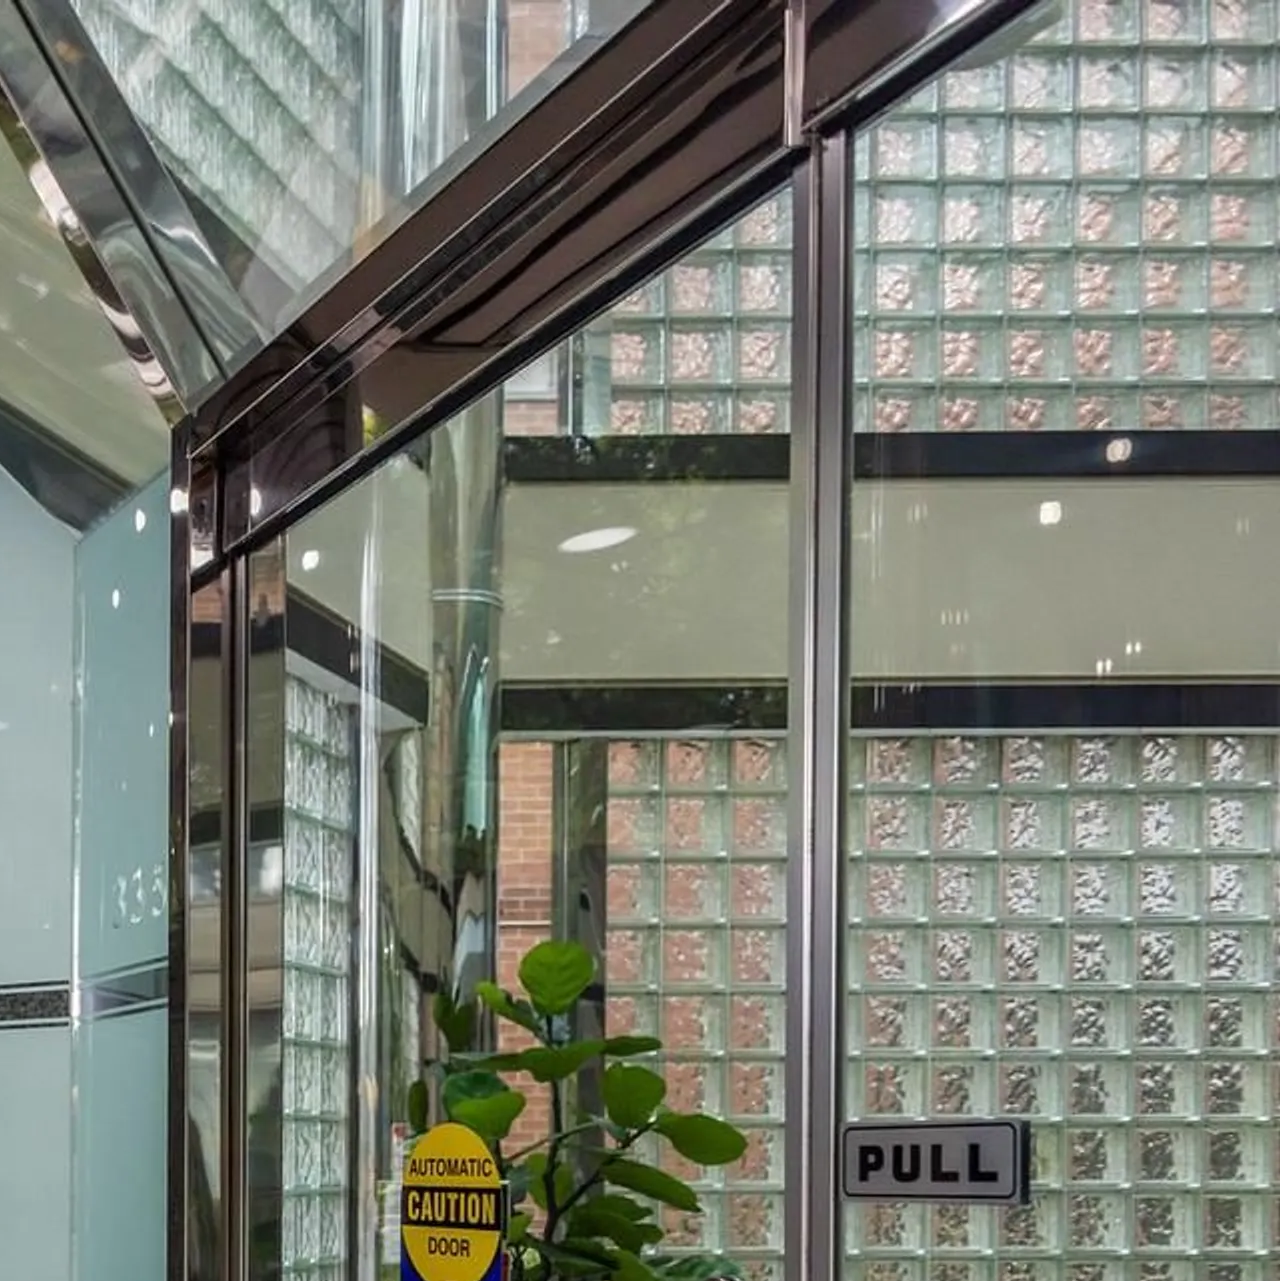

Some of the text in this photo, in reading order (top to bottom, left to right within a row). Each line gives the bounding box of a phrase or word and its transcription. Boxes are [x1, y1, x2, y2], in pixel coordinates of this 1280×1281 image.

[409, 1158, 493, 1178] AUTOMATIC
[858, 1143, 999, 1183] PULL
[407, 1190, 496, 1225] CAUTION
[428, 1236, 471, 1257] DOOR
